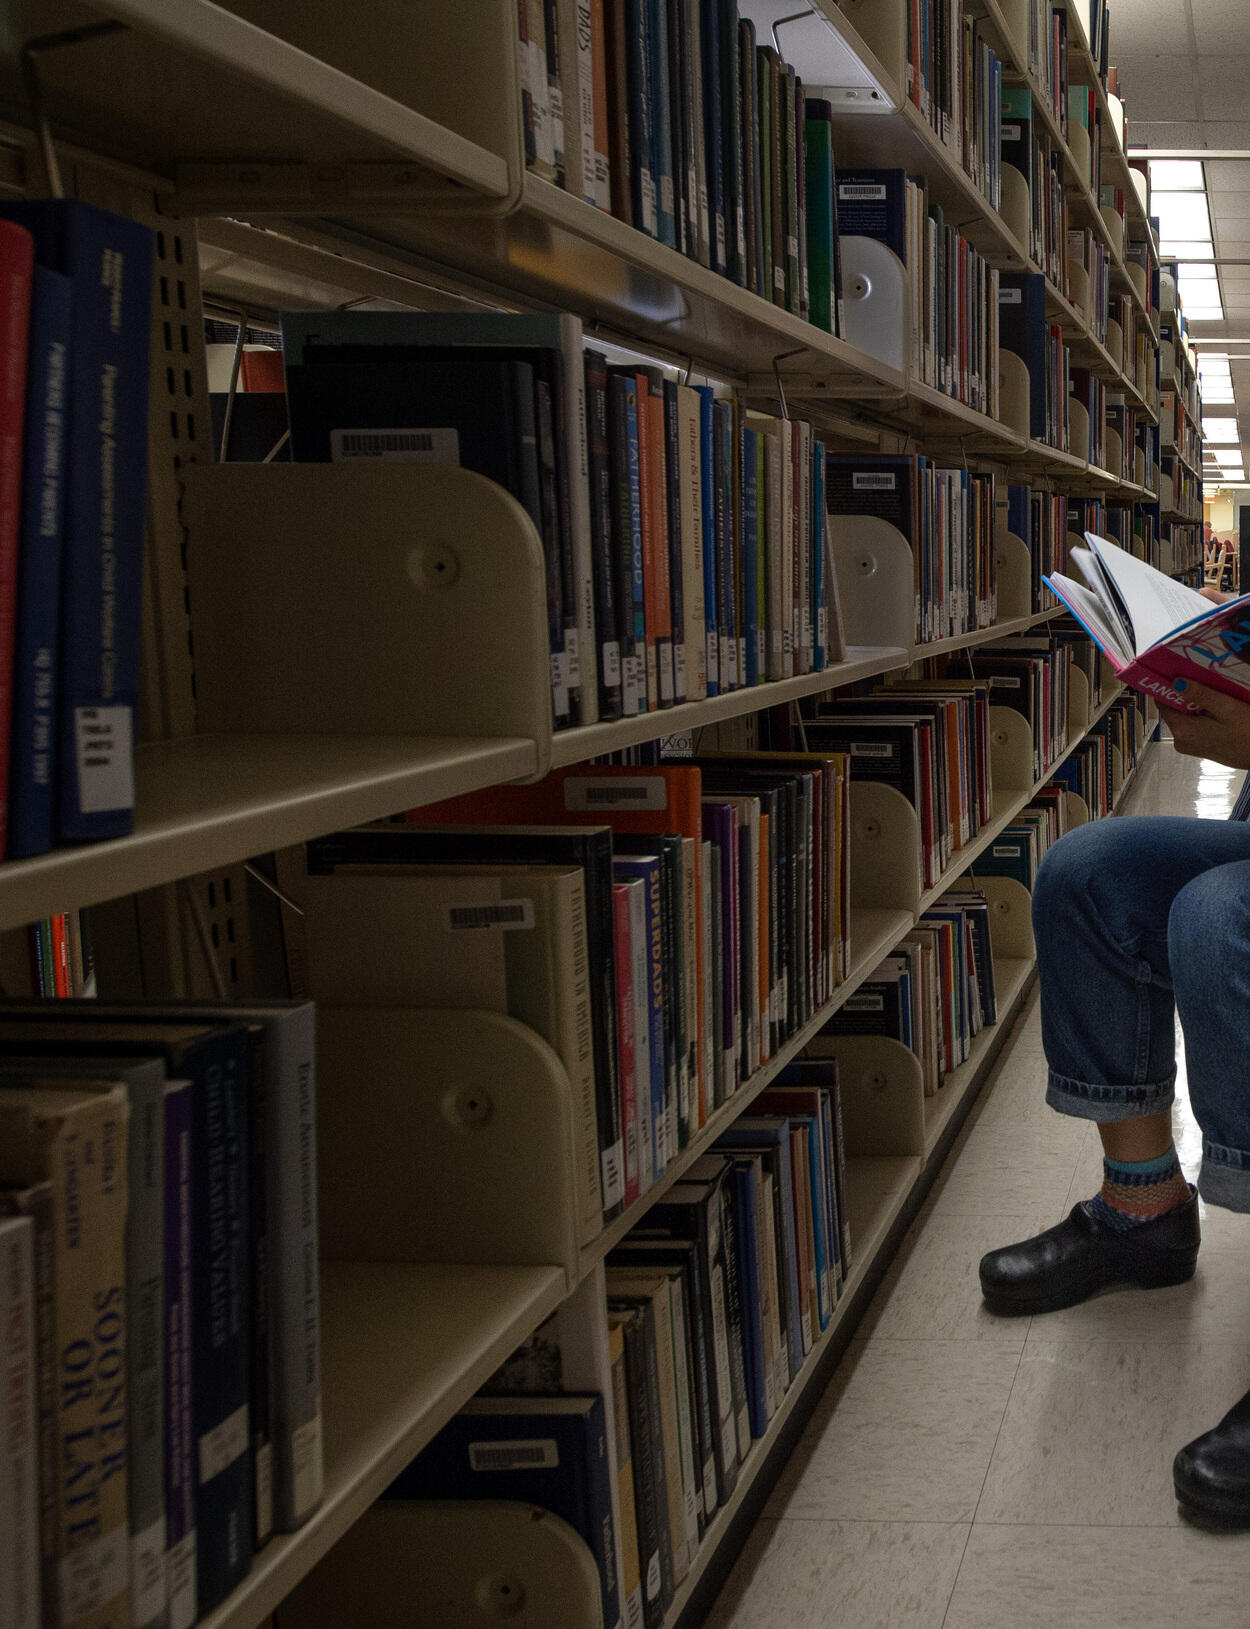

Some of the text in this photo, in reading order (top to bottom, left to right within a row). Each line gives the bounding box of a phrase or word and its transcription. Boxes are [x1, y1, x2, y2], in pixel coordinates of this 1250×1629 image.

[576, 5, 590, 53] DADS
[38, 341, 66, 537] PARTNERS BECOMING PARENTS
[97, 363, 118, 435] Parenting
[577, 388, 587, 477] Fatherhood
[628, 437, 642, 585] FATHERHOOD
[688, 417, 700, 570] Fathers & Their Families
[716, 487, 726, 548] FATHERS
[100, 552, 118, 594] Child
[1137, 676, 1186, 705] LANCE
[569, 887, 585, 976] FATHERHOOD
[648, 868, 662, 1010] SUPERDADS
[574, 979, 586, 996] IN
[573, 1000, 589, 1062] AMERICA
[297, 1061, 312, 1115] Erotic
[93, 1285, 124, 1484] SOONER
[60, 1340, 98, 1547] OR LATE
